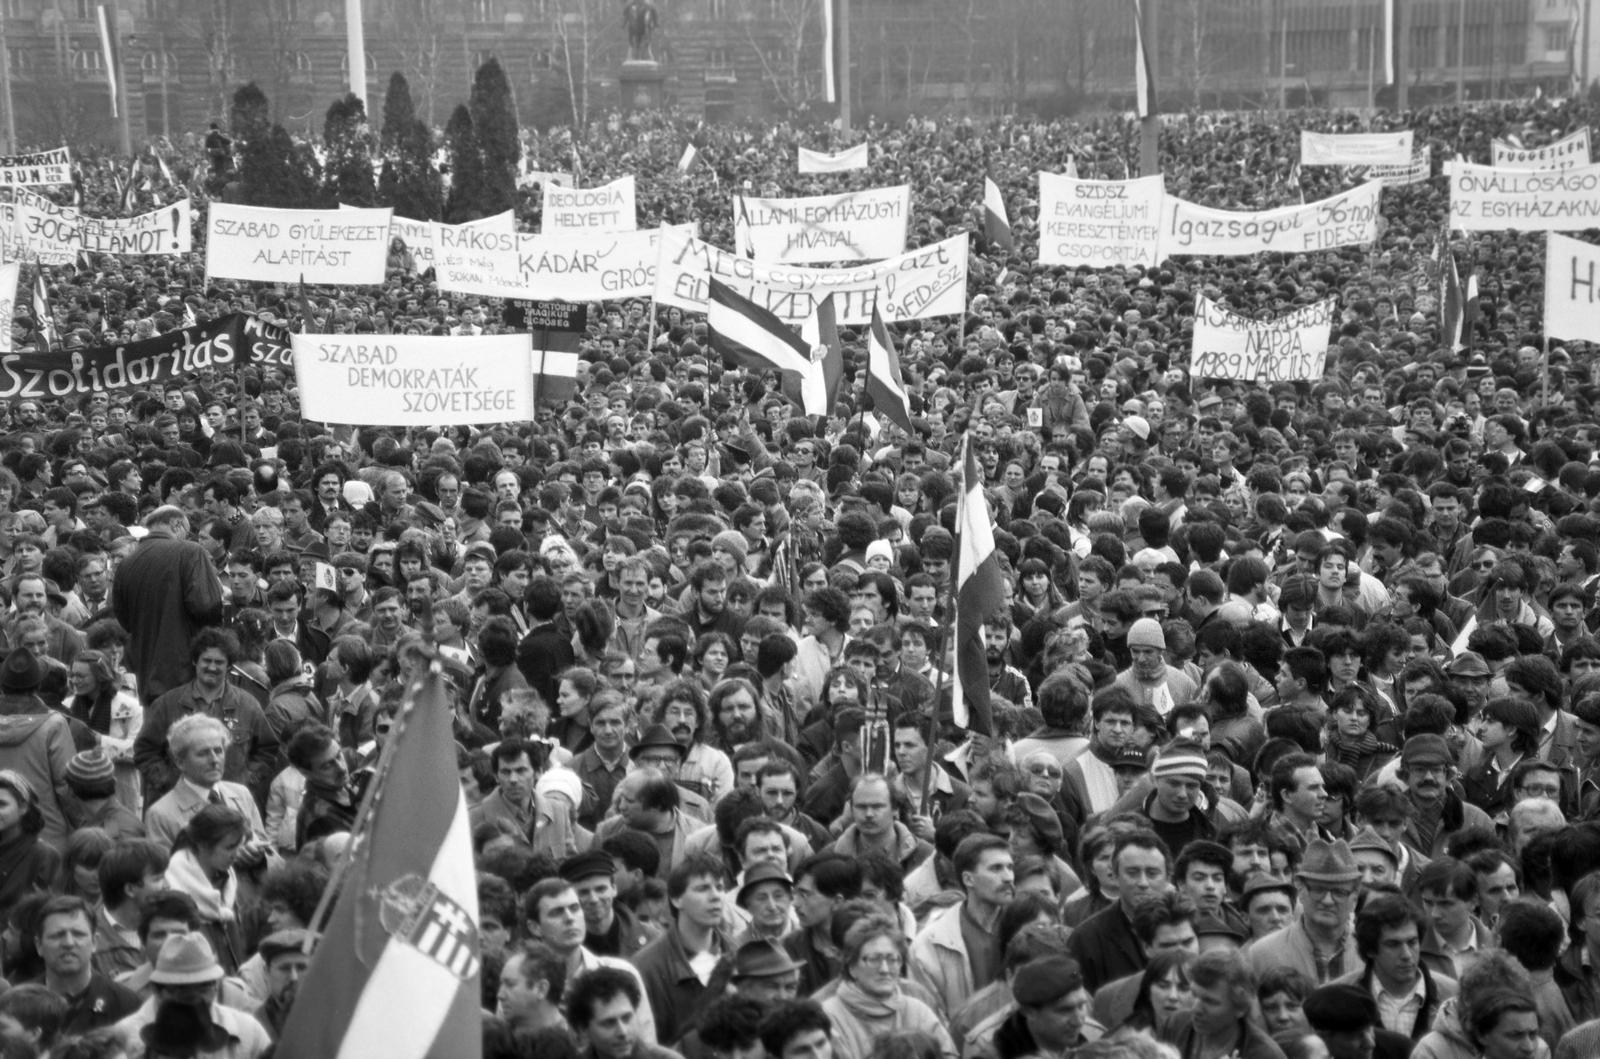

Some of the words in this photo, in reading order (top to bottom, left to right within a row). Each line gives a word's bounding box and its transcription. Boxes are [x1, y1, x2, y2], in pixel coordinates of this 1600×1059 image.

[1074, 184, 1129, 199] SZDSZ
[1458, 170, 1600, 193] ÖNÁLLÓSÁGO
[554, 211, 619, 227] HELYETT
[1055, 199, 1148, 220] EVANGÉLIUMI
[1450, 200, 1471, 217] AZ
[213, 218, 280, 239] SZABAD
[440, 225, 518, 252] RÁKOSI
[787, 230, 858, 248] HIVATAL
[1303, 223, 1369, 250] FIDESZ
[252, 243, 352, 267] ALAPÍTÁST
[518, 249, 599, 274] KÁDÁR
[899, 244, 950, 271] azt
[1057, 242, 1149, 262] CSOPORTJA
[1245, 330, 1302, 355] NAPJA
[0, 330, 235, 398] Szolidaritás
[317, 344, 397, 366] SZABAD
[347, 361, 478, 390] DEMOKRATÁK
[402, 386, 516, 413] SZÖVETSÉGE
